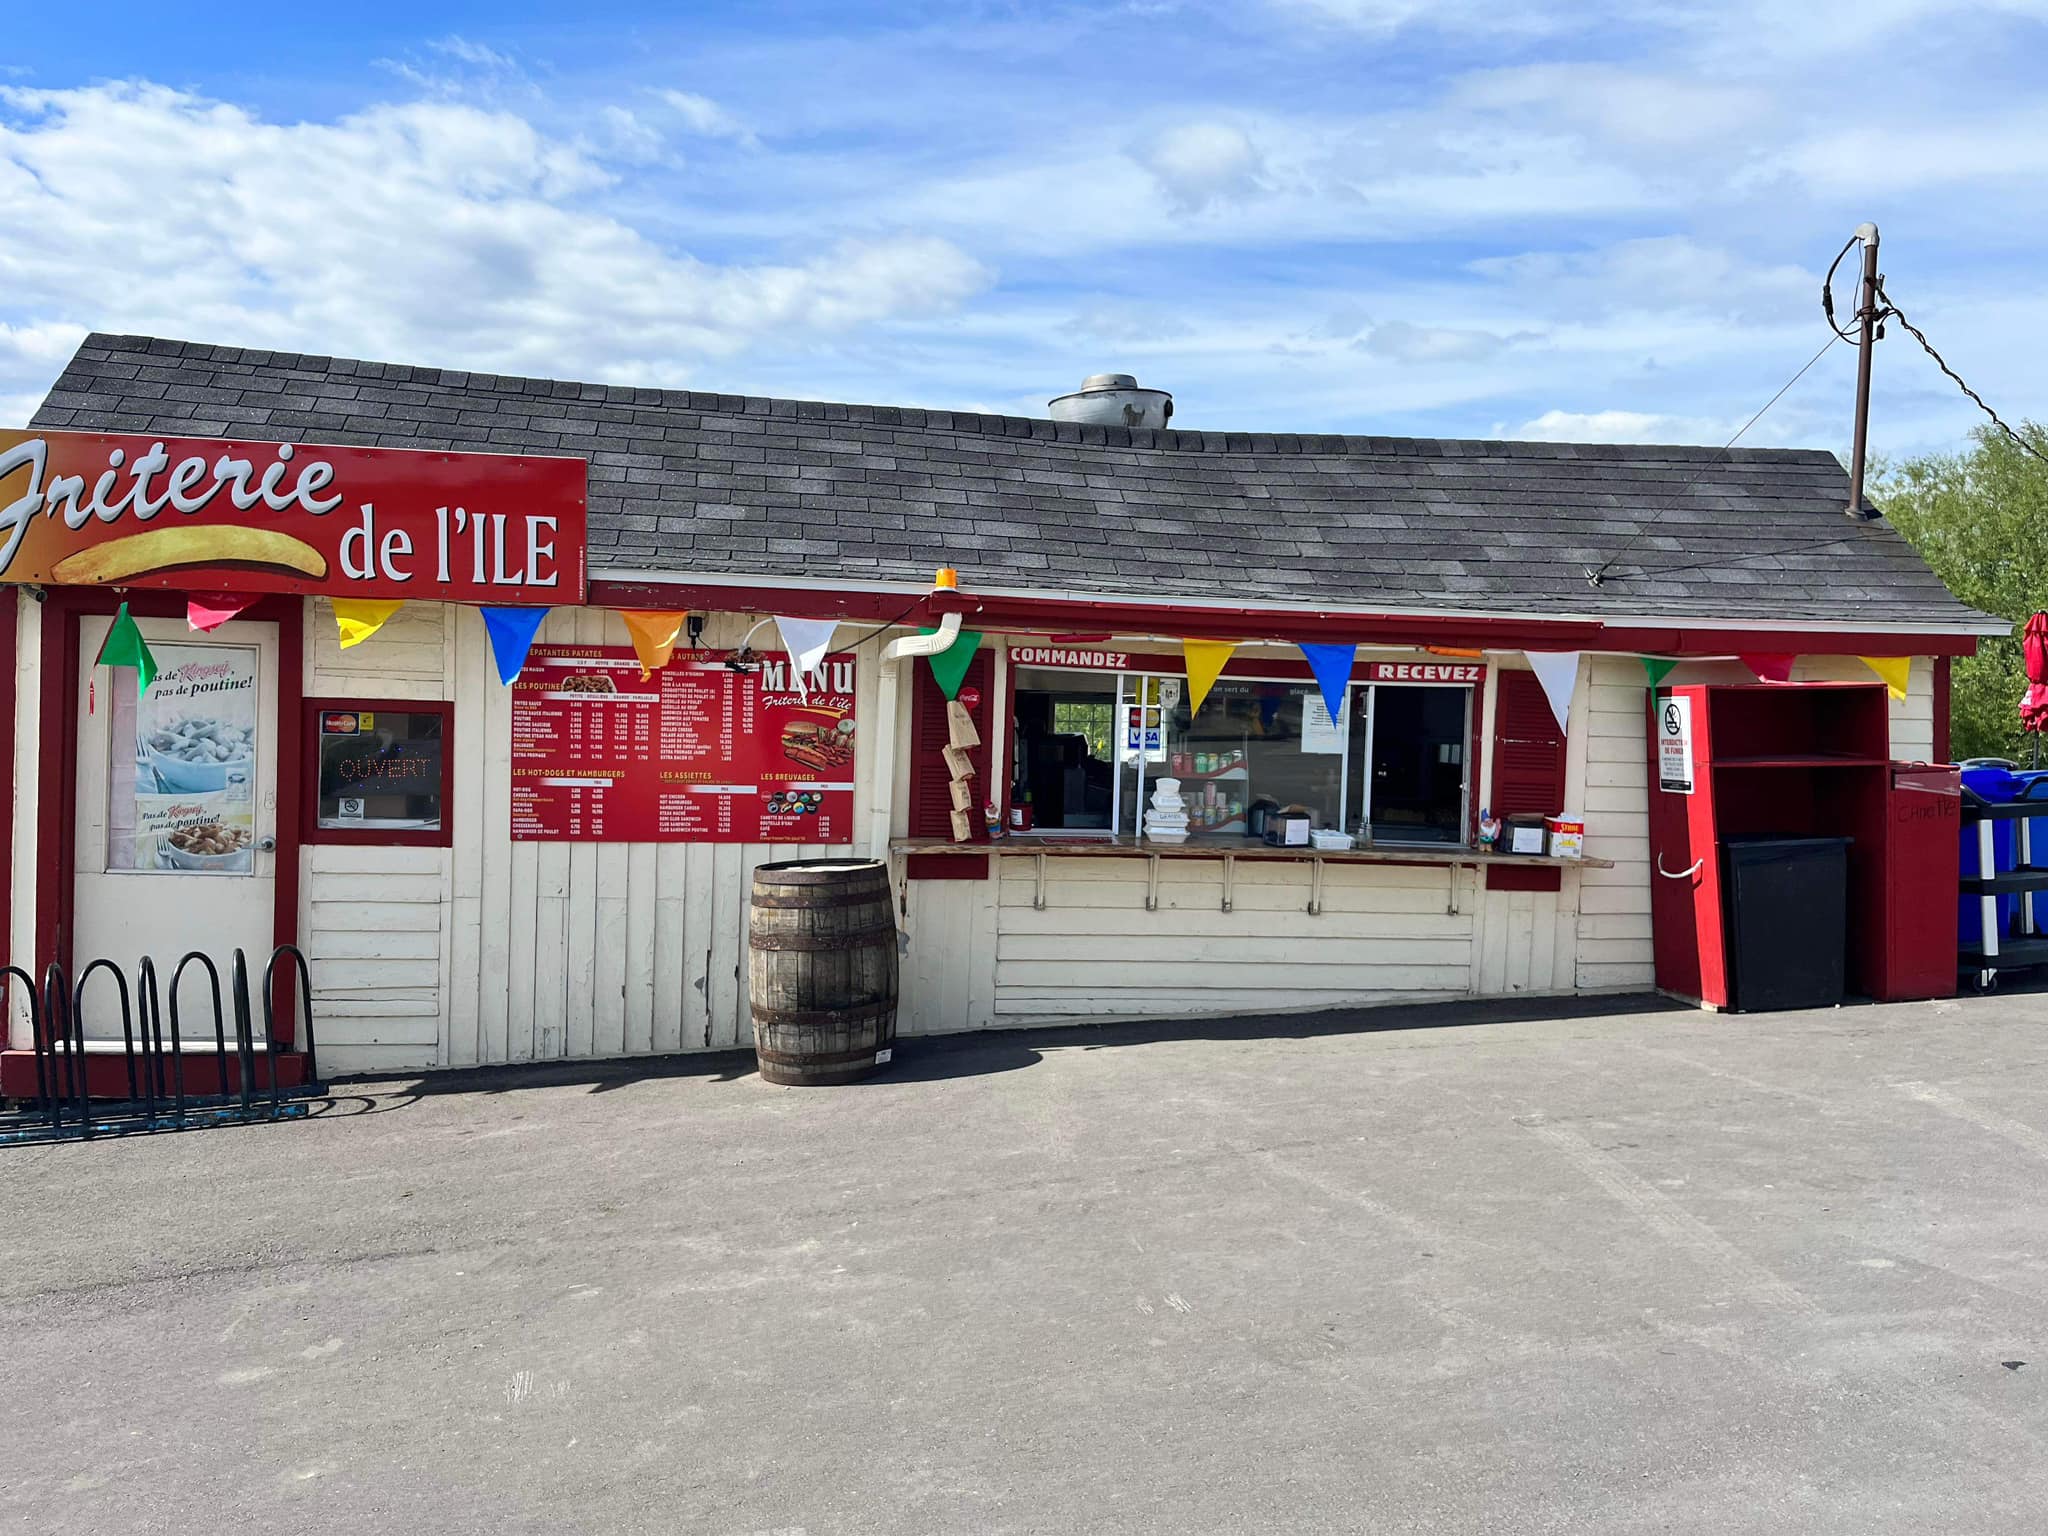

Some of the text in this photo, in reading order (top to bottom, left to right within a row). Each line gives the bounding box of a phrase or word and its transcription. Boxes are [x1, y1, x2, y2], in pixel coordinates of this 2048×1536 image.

[0, 439, 342, 577] Friterie
[339, 504, 413, 581] de
[572, 650, 602, 658] PATATES
[1011, 648, 1127, 667] COMMANDEZ
[165, 671, 177, 681] de
[1378, 664, 1479, 680] RECEVEZ
[155, 676, 253, 700] pas de poutine!
[514, 682, 528, 690] LES
[762, 696, 807, 710] Friteri
[812, 696, 825, 705] de
[1133, 732, 1158, 741] VSA
[339, 759, 431, 778] OUVERT
[513, 768, 526, 776] LES
[528, 769, 564, 777] HOT-DOGS
[578, 770, 625, 778] HAMBURGERS
